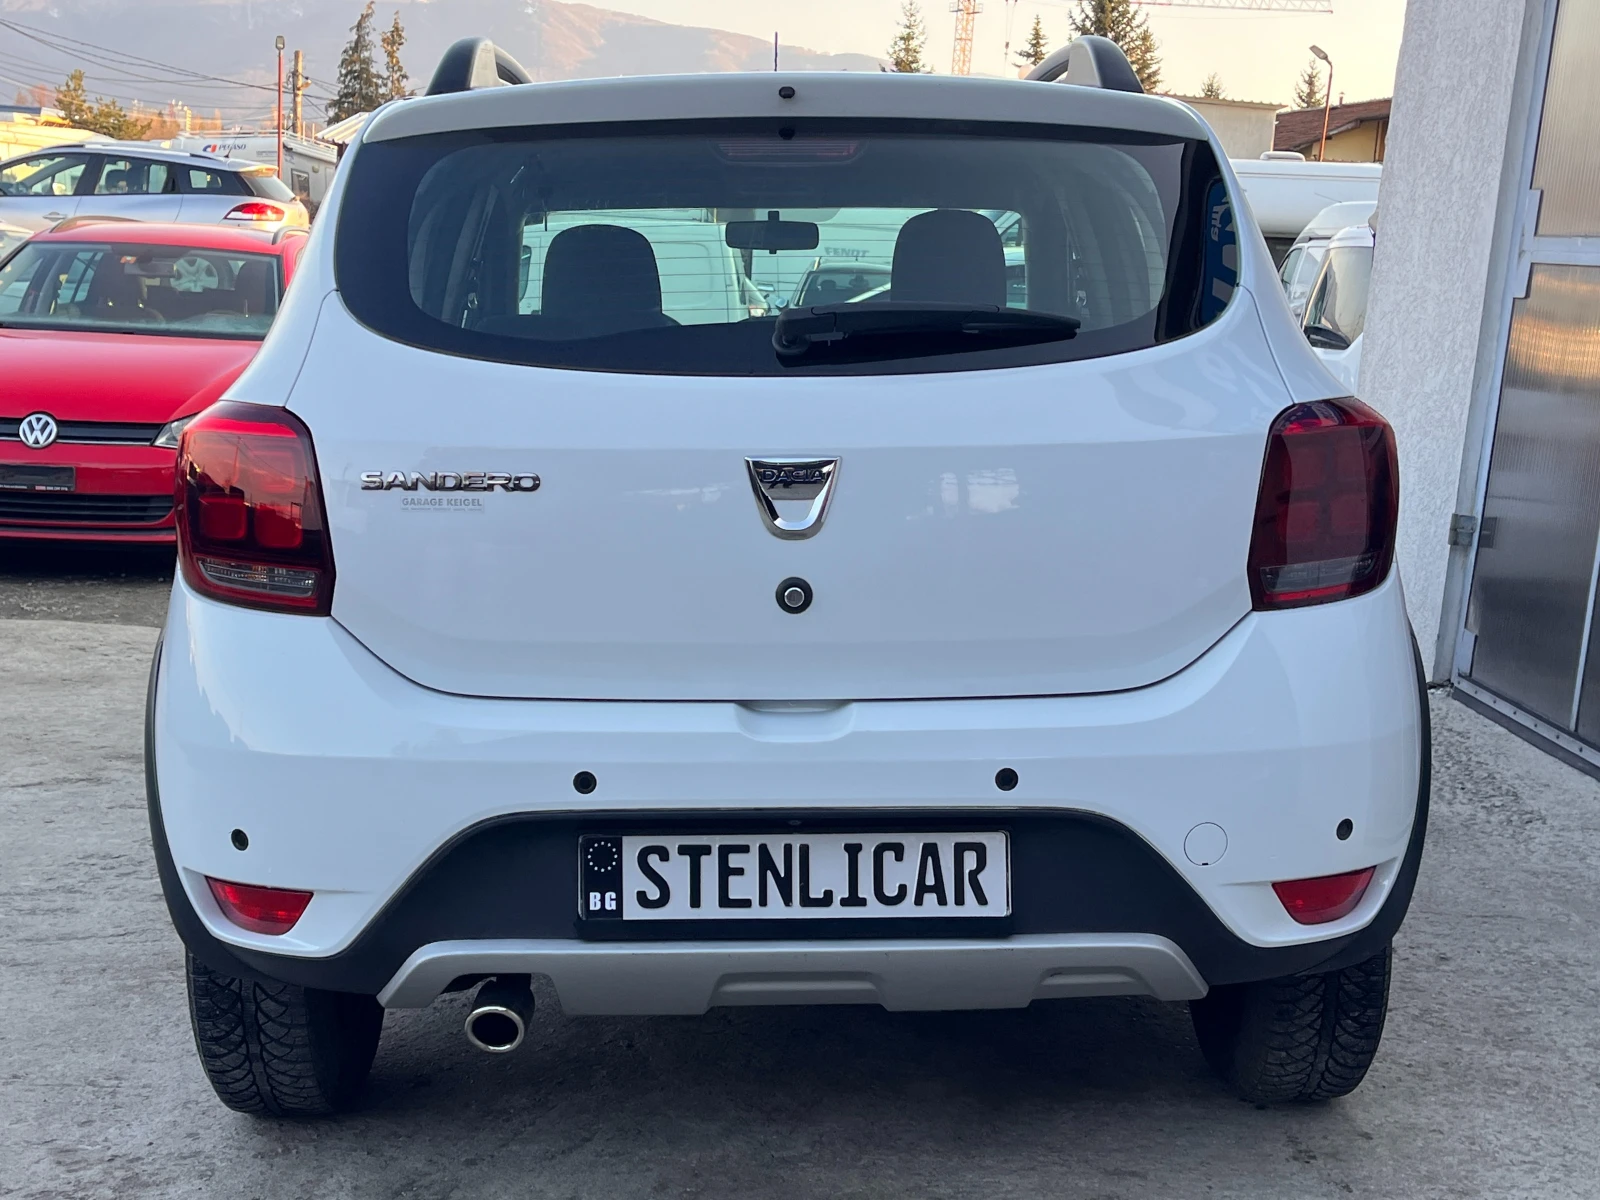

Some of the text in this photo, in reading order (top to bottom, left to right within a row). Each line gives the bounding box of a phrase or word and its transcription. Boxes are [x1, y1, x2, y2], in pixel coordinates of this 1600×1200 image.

[824, 247, 870, 257] FENDT
[20, 414, 57, 448] VW
[360, 471, 541, 492] SANDERO
[761, 468, 823, 481] DACIA
[402, 498, 483, 507] GARAGE KEIGEL
[636, 842, 989, 909] STENLICAR
[589, 892, 617, 911] BG
